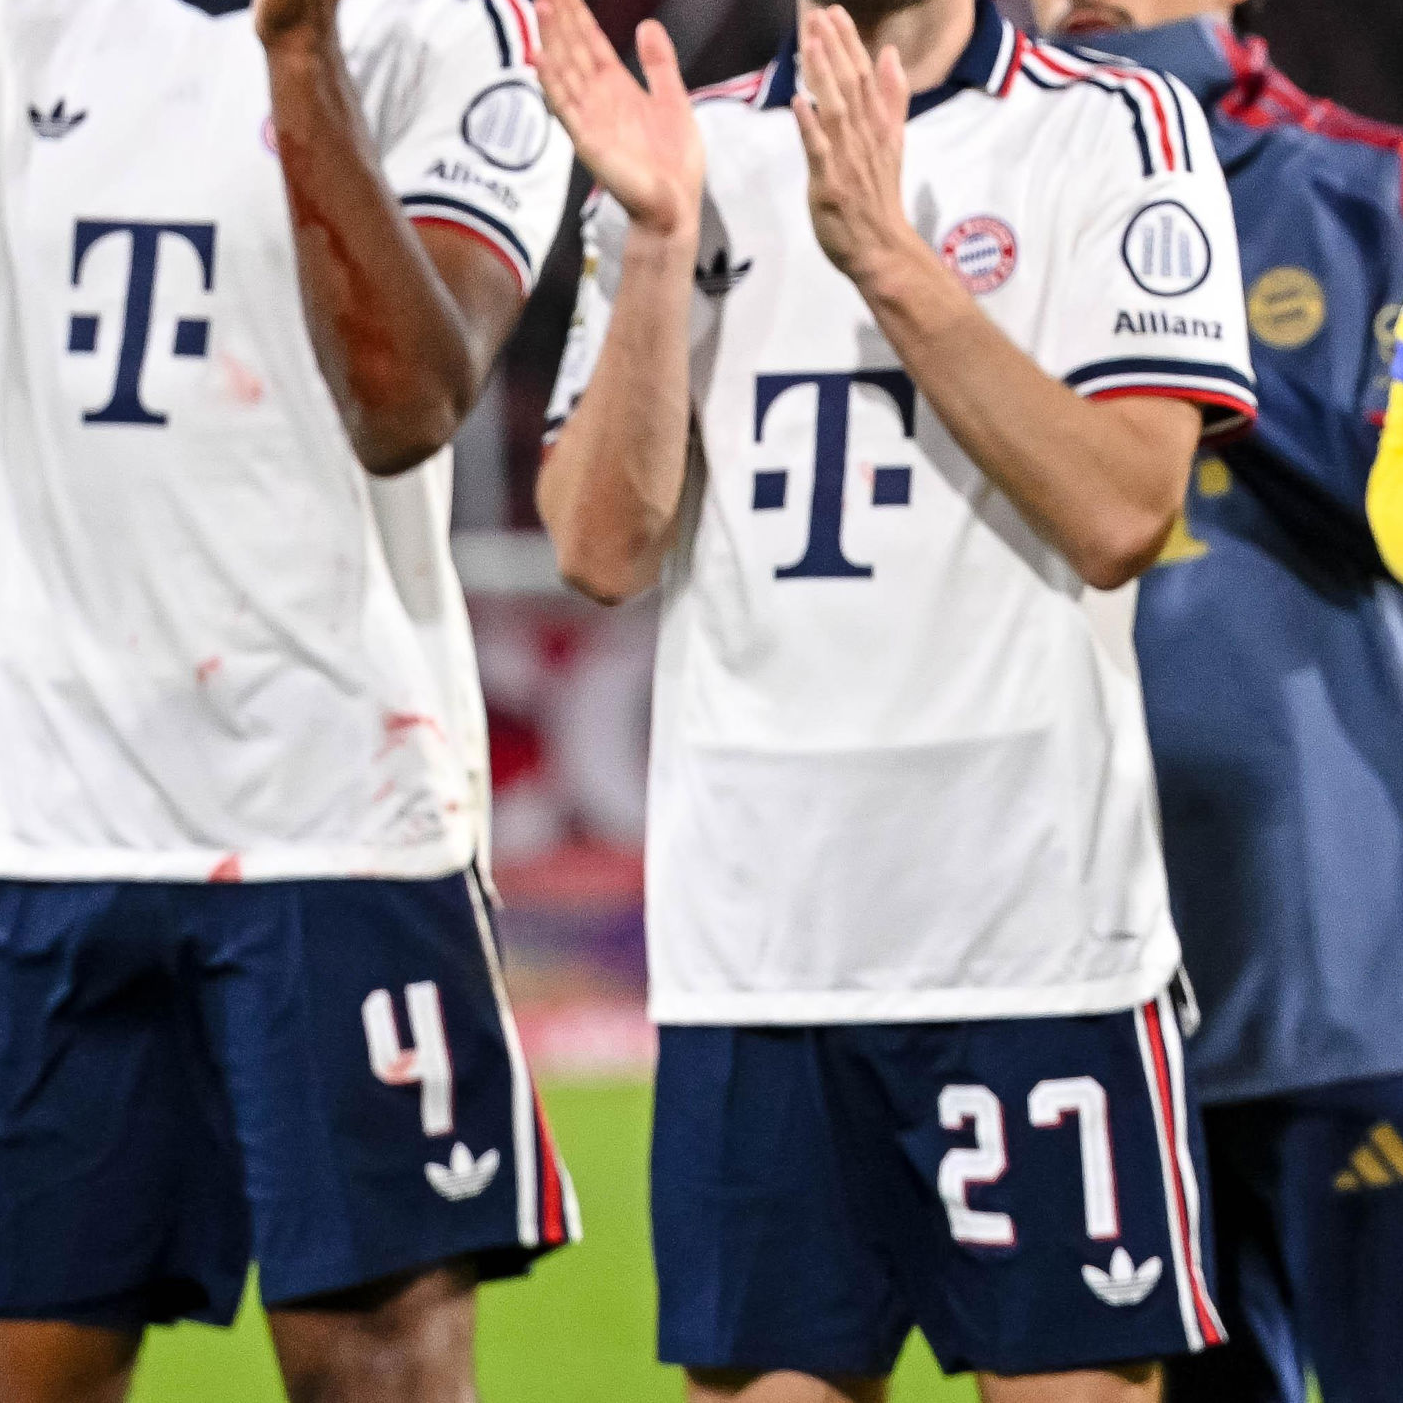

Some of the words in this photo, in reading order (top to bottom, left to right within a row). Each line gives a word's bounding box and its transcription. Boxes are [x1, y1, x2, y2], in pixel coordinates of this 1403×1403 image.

[1112, 309, 1223, 339] Allianz
[361, 980, 455, 1137] 4
[937, 1075, 1122, 1249] 27
